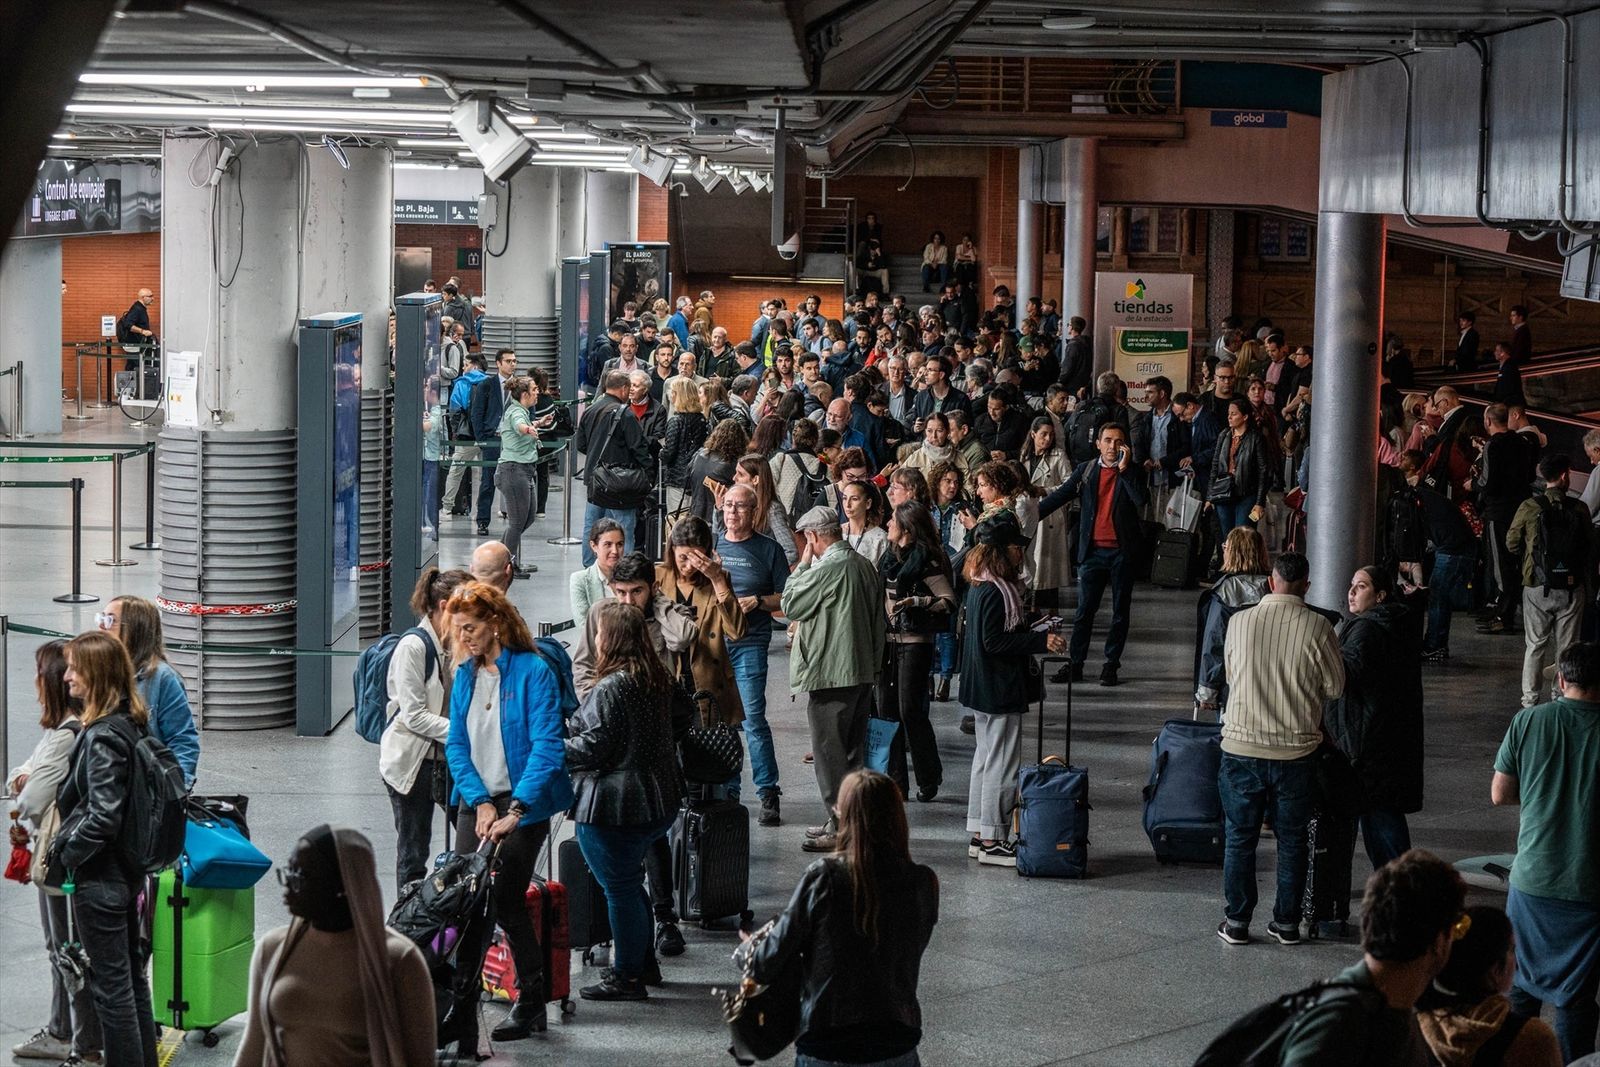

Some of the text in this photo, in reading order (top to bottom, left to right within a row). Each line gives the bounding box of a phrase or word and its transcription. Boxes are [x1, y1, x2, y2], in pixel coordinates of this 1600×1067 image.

[1233, 113, 1265, 126] global
[45, 177, 105, 203] Control de equipajes
[45, 209, 77, 222] LUGGAGE CONTROL
[418, 204, 434, 214] Baja
[1113, 300, 1174, 314] tiendas
[1143, 315, 1174, 323] estación
